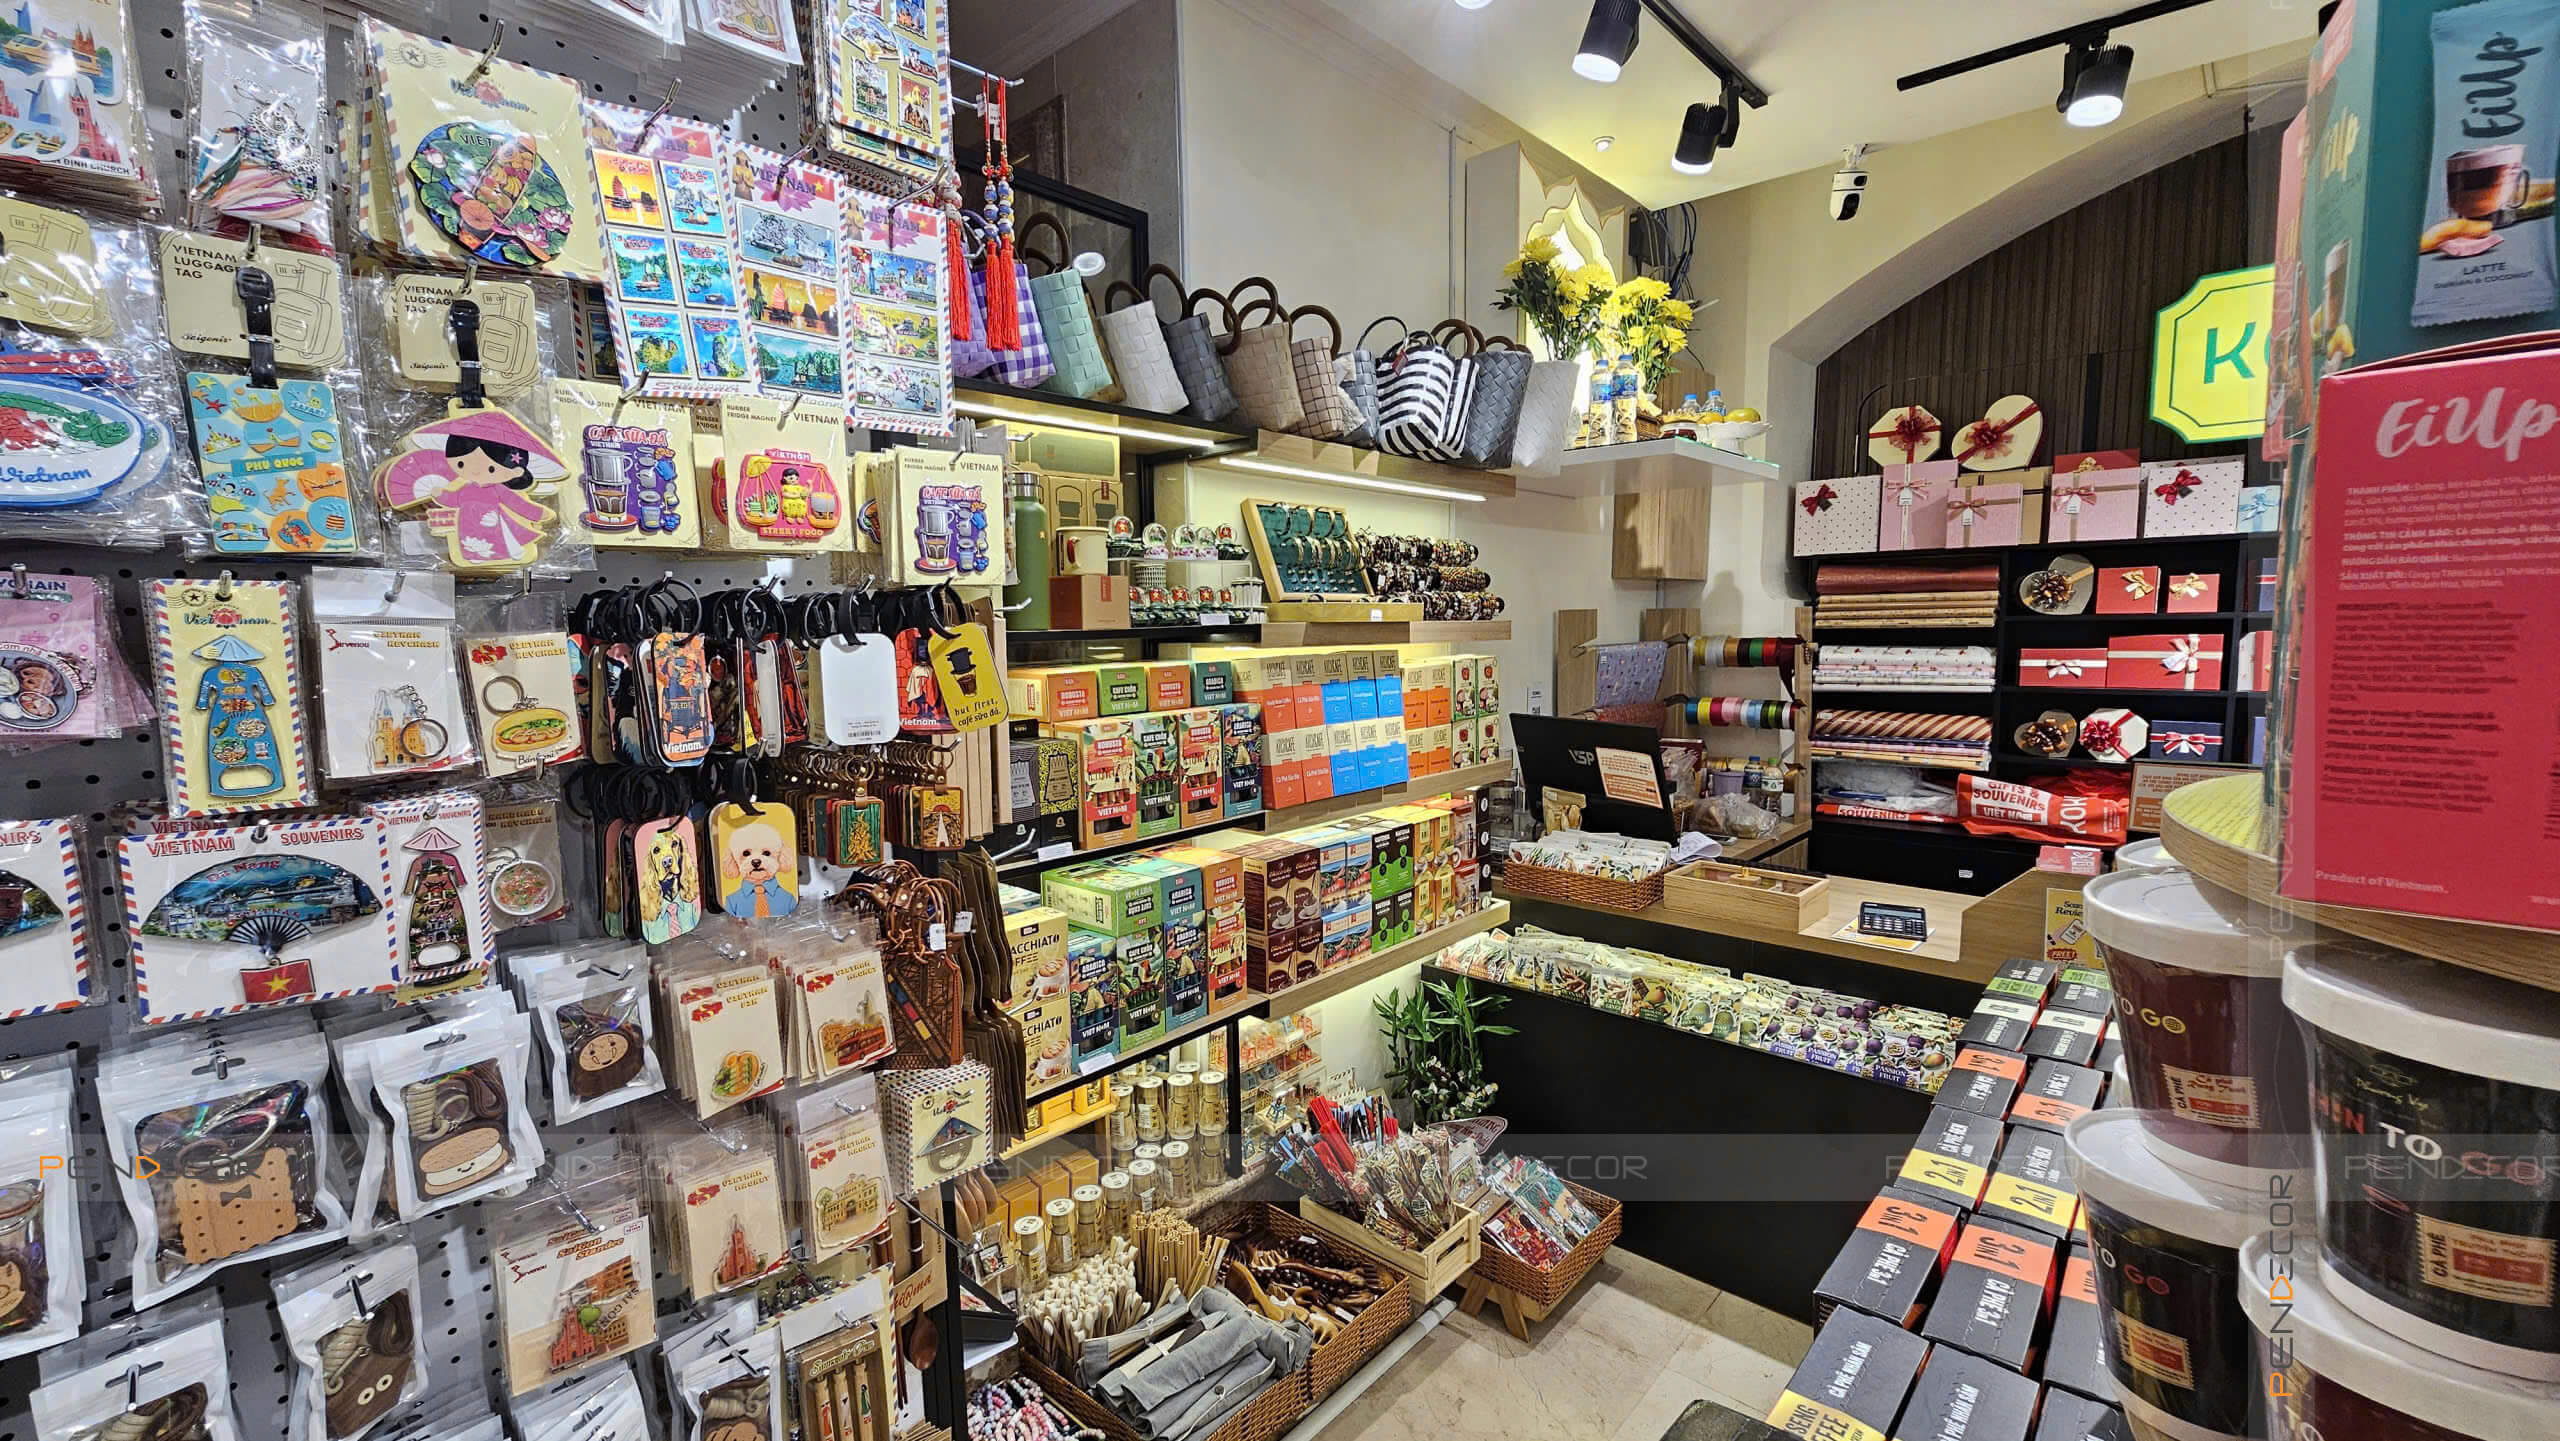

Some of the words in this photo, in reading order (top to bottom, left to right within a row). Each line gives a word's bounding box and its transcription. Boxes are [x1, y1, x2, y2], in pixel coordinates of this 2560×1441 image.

[2459, 30, 2545, 139] EiUp
[172, 244, 237, 264] VIETNAM
[175, 268, 203, 279] TAG
[2463, 261, 2507, 276] LATTE
[2483, 270, 2535, 285] COCONUT
[404, 285, 453, 297] VIETNAM
[793, 412, 840, 425] VIETNAM
[2376, 386, 2560, 463] EiUp
[960, 461, 999, 472] VIETNAM
[1973, 787, 2046, 811] SOUVENIRS
[1983, 806, 2006, 818] VIET
[387, 815, 421, 825] VIETNAM
[280, 827, 365, 846] SOUVENIRS
[147, 836, 235, 857] VIETNAM
[2315, 870, 2366, 886] Product
[2368, 876, 2384, 886] of
[1172, 888, 1192, 899] ARABICA
[2056, 907, 2083, 916] Revie
[1082, 960, 1106, 972] ARABICA
[2140, 1007, 2187, 1034] GO
[1807, 1047, 1837, 1060] PASSION
[1811, 1052, 1833, 1065] FRUIT
[1875, 1065, 1907, 1078] PASSION
[1879, 1071, 1901, 1083] FRUIT
[2378, 1121, 2443, 1161] TO
[2461, 1151, 2544, 1186] GO
[2124, 1264, 2170, 1295] GO
[1834, 1370, 1858, 1390] PHÊ
[1829, 1382, 1851, 1399] CÀ
